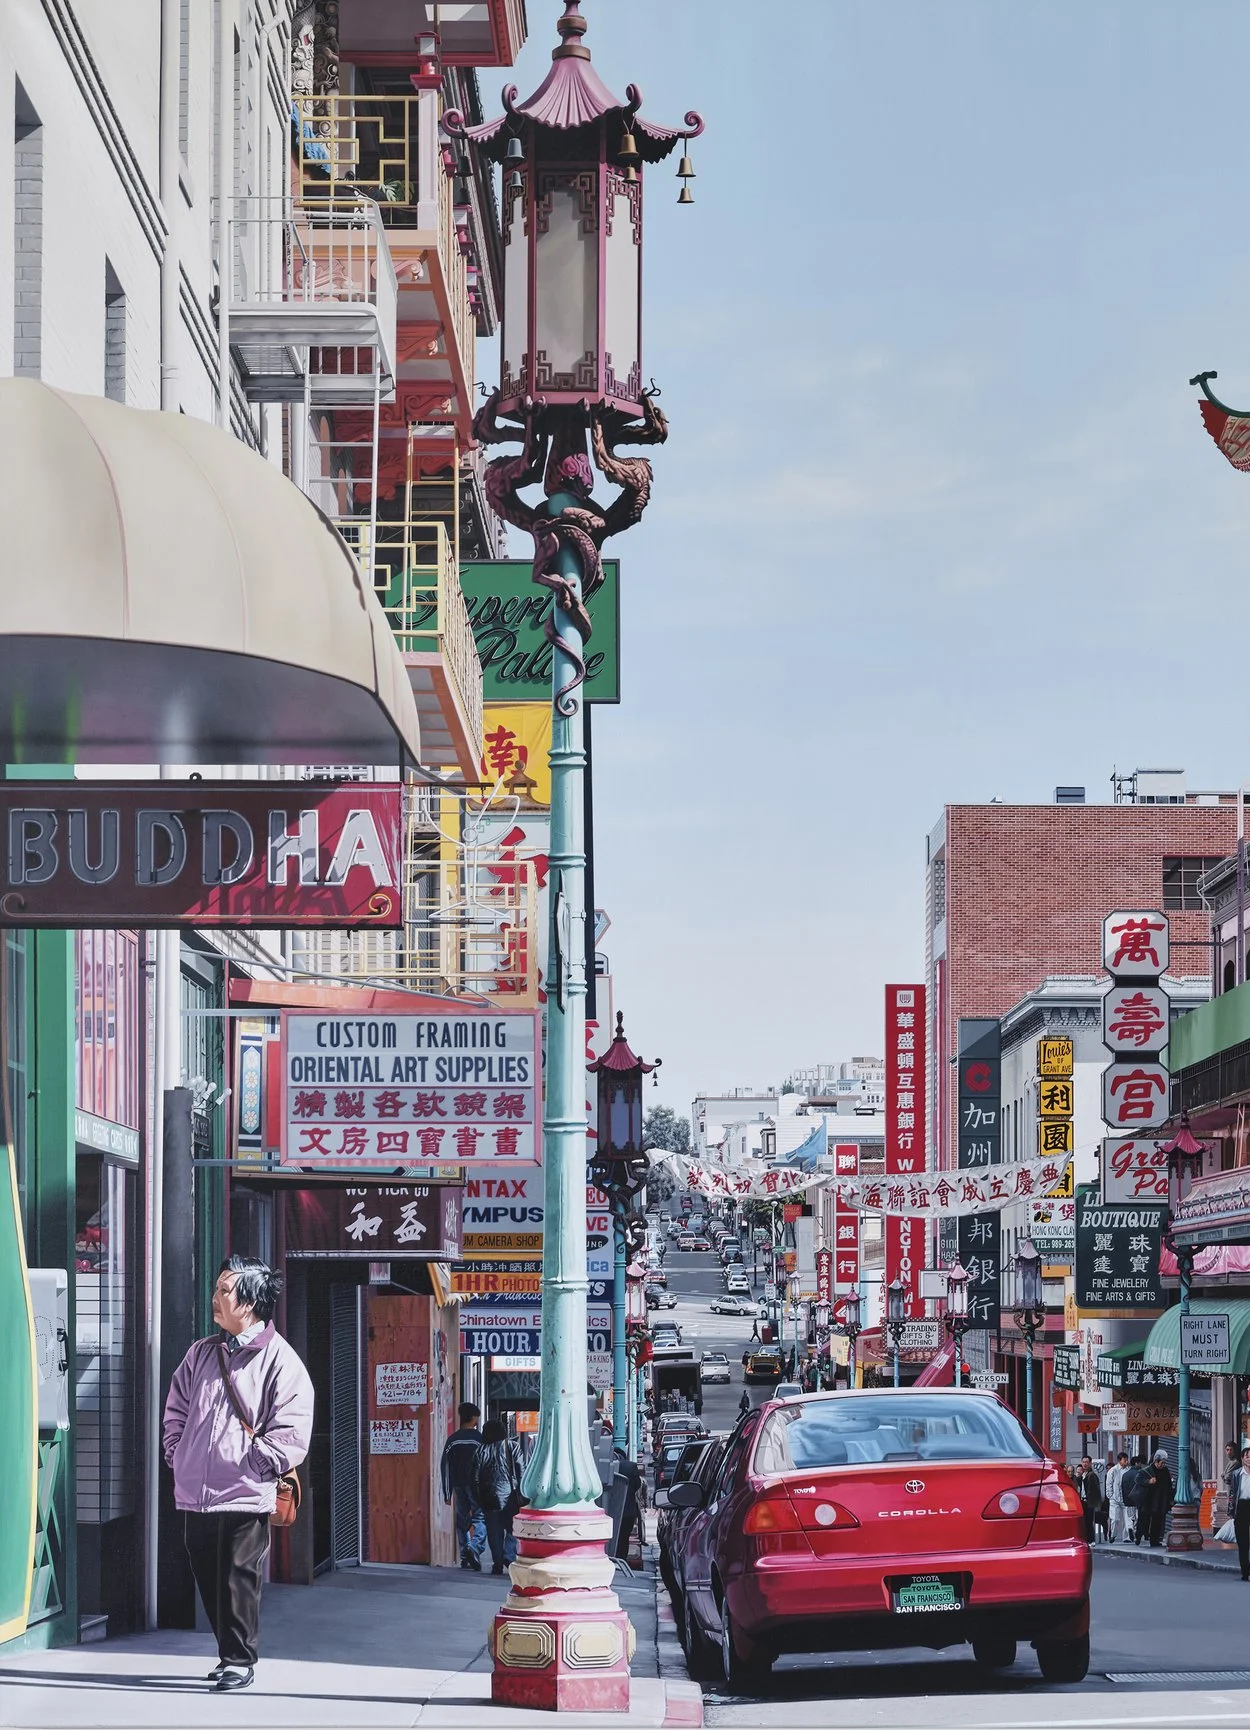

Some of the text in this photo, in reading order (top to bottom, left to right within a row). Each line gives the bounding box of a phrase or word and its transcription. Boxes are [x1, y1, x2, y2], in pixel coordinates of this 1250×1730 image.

[8, 808, 393, 887] BUDDHA
[1109, 918, 1166, 1123] 萬壽宮
[316, 1021, 507, 1048] CUSTOM FRAMING
[1041, 1041, 1072, 1064] Louie's
[290, 1056, 529, 1082] ORIENTAL ART SUPPLIES
[1043, 1065, 1072, 1074] GRANT AVE
[896, 1012, 915, 1149] 華盛頓互惠銀行
[298, 1126, 524, 1158] 文房四寶書畫
[463, 1179, 527, 1199] NTAX
[462, 1207, 544, 1223] YMPUS
[837, 1154, 858, 1273] 聯銀行
[963, 1101, 998, 1322] 加州邦銀行
[1080, 1211, 1161, 1228] BOUTIQUE
[344, 1201, 427, 1244] 和益
[1031, 1225, 1047, 1236] HONG
[1047, 1225, 1062, 1236] KONG
[477, 1236, 540, 1247] CAMERA SHOP
[453, 1273, 540, 1292] 1HR PHOTO
[1092, 1278, 1150, 1288] FINE JEWELERY
[1086, 1291, 1156, 1301] FINE ARTS & GIFTS
[459, 1314, 527, 1326] Chinatown
[1183, 1319, 1227, 1330] RIGHT LANE
[472, 1332, 531, 1353] HOUR
[1192, 1333, 1219, 1344] MUST
[505, 1357, 536, 1367] GIFTS
[1184, 1349, 1203, 1359] TURN
[1206, 1349, 1228, 1358] RIGHT
[878, 1507, 962, 1518] COROLLA
[903, 1592, 951, 1604] SAN FRANCISCO
[896, 1602, 961, 1614] SAN FRANCISCO
